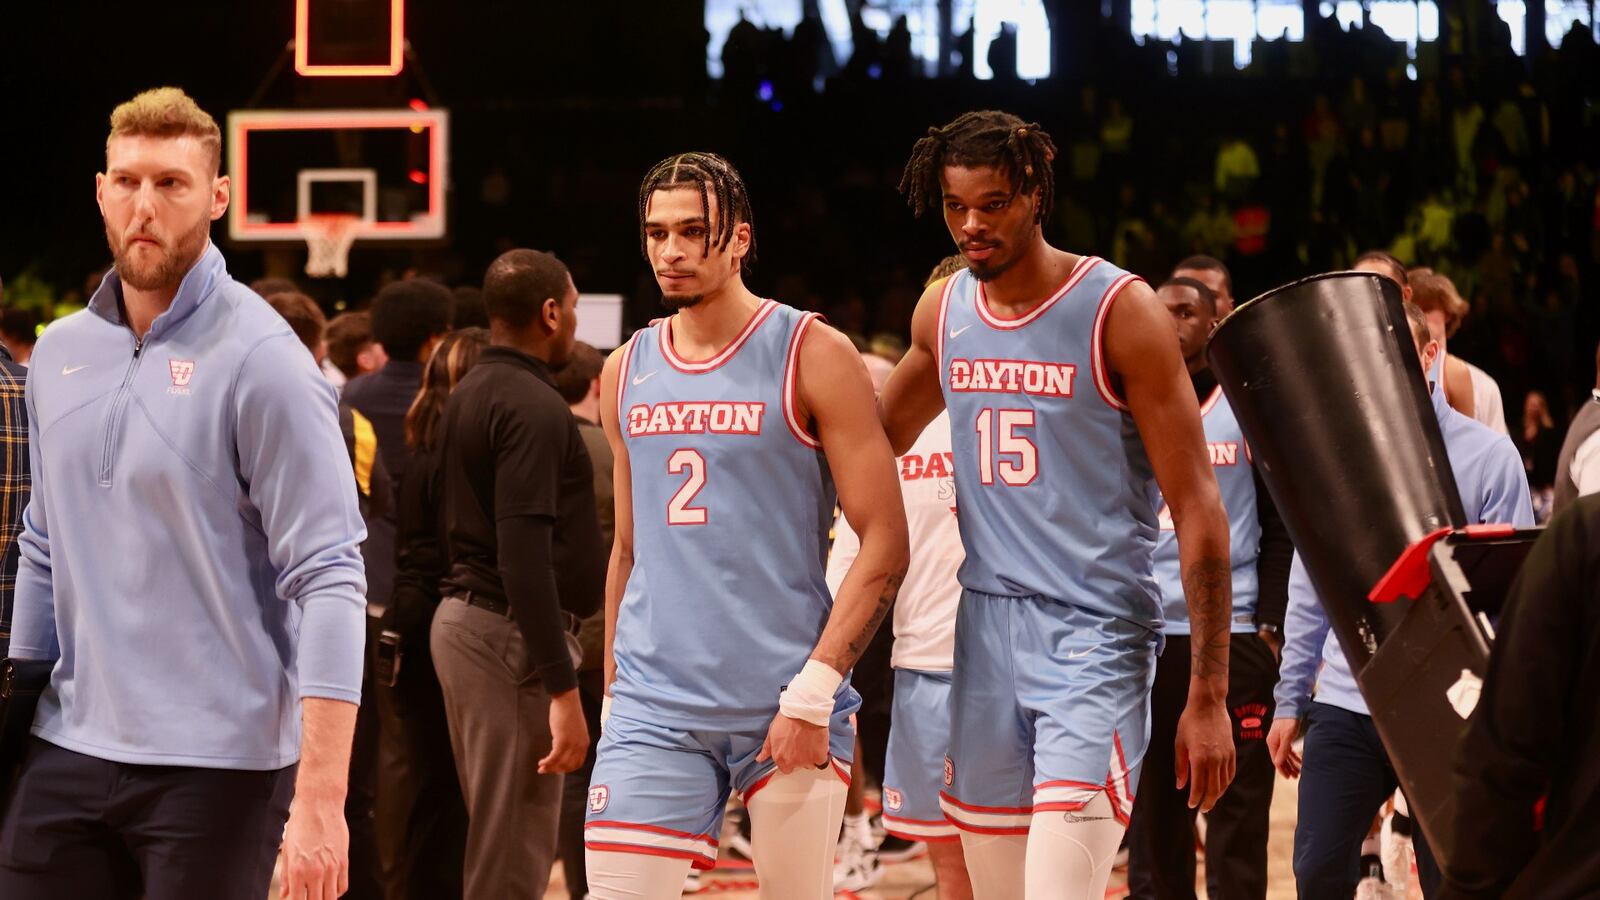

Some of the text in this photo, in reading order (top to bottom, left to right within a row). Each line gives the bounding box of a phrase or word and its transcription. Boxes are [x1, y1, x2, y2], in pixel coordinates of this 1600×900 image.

[950, 358, 1076, 399] DAYTON
[627, 401, 766, 438] DAYTON
[976, 407, 1038, 487] 15
[668, 448, 707, 525] 2
